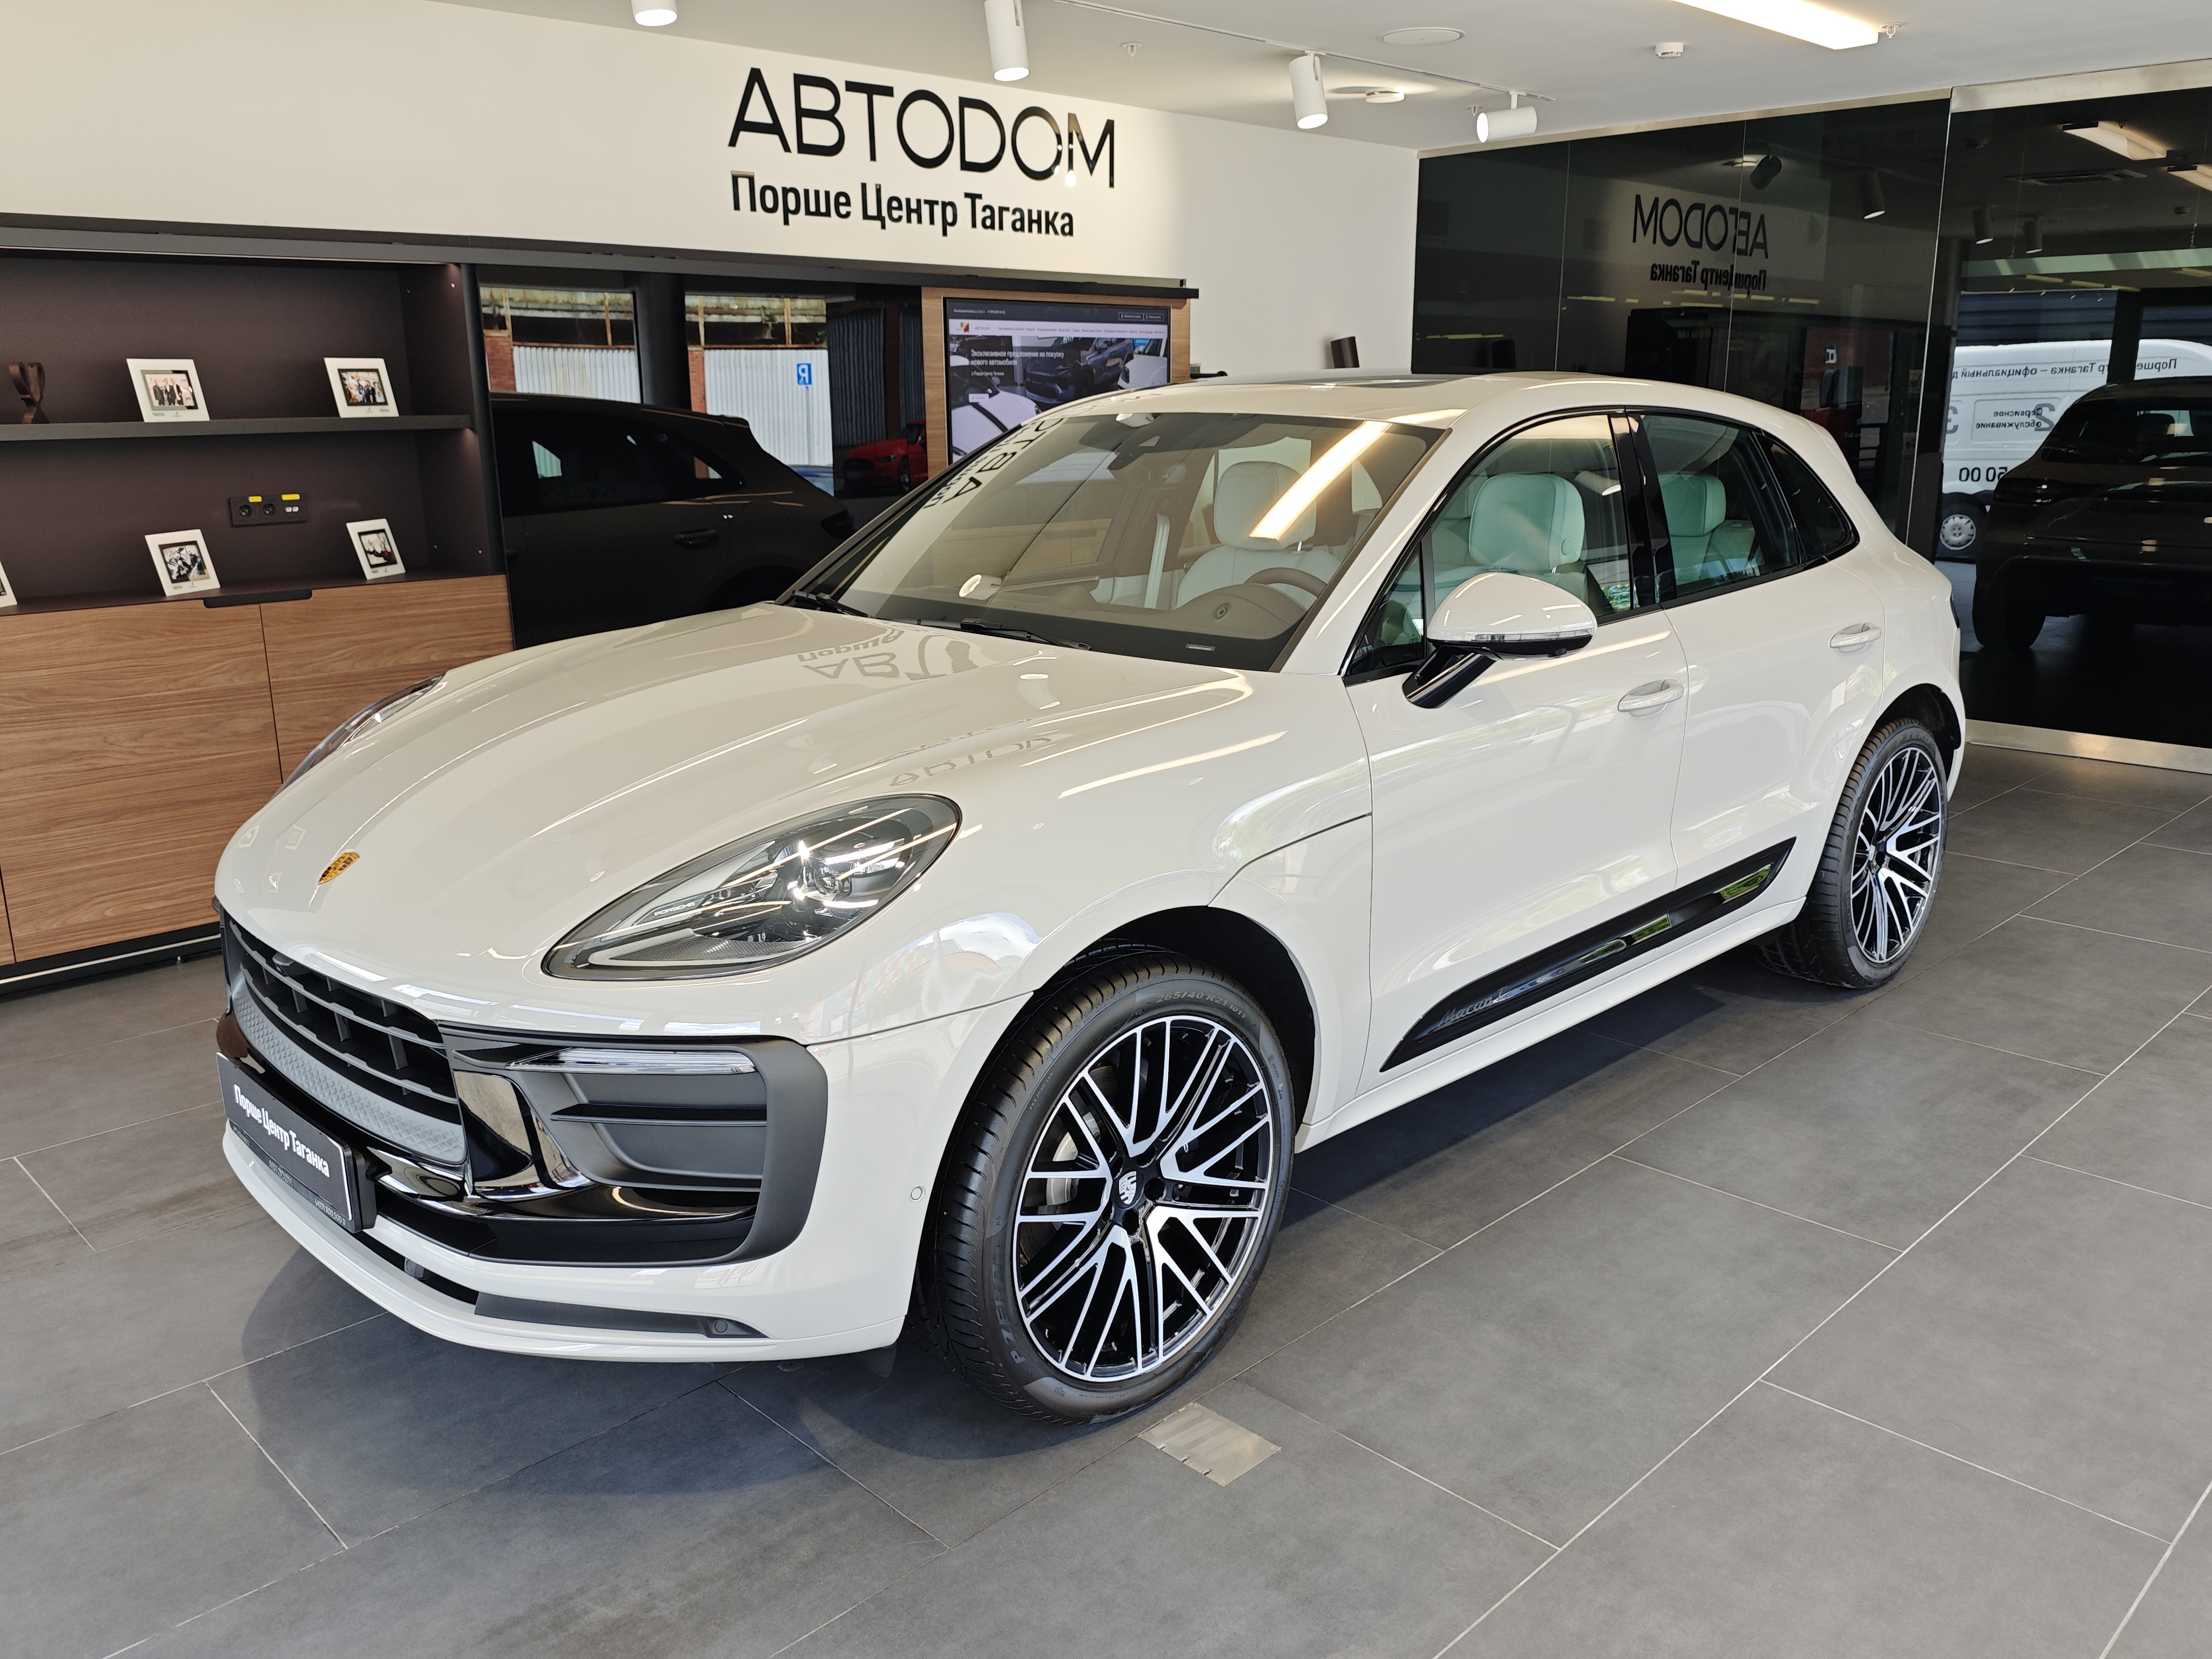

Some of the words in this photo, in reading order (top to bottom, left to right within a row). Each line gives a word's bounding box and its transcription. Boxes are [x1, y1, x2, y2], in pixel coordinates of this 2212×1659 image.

[731, 170, 851, 225] Порше
[861, 182, 958, 237] Центр
[964, 192, 1074, 237] Таганка
[1438, 997, 1494, 1027] Macan
[233, 1084, 262, 1123] Порше
[262, 1107, 291, 1151] Центр
[289, 1130, 330, 1178] Таганка
